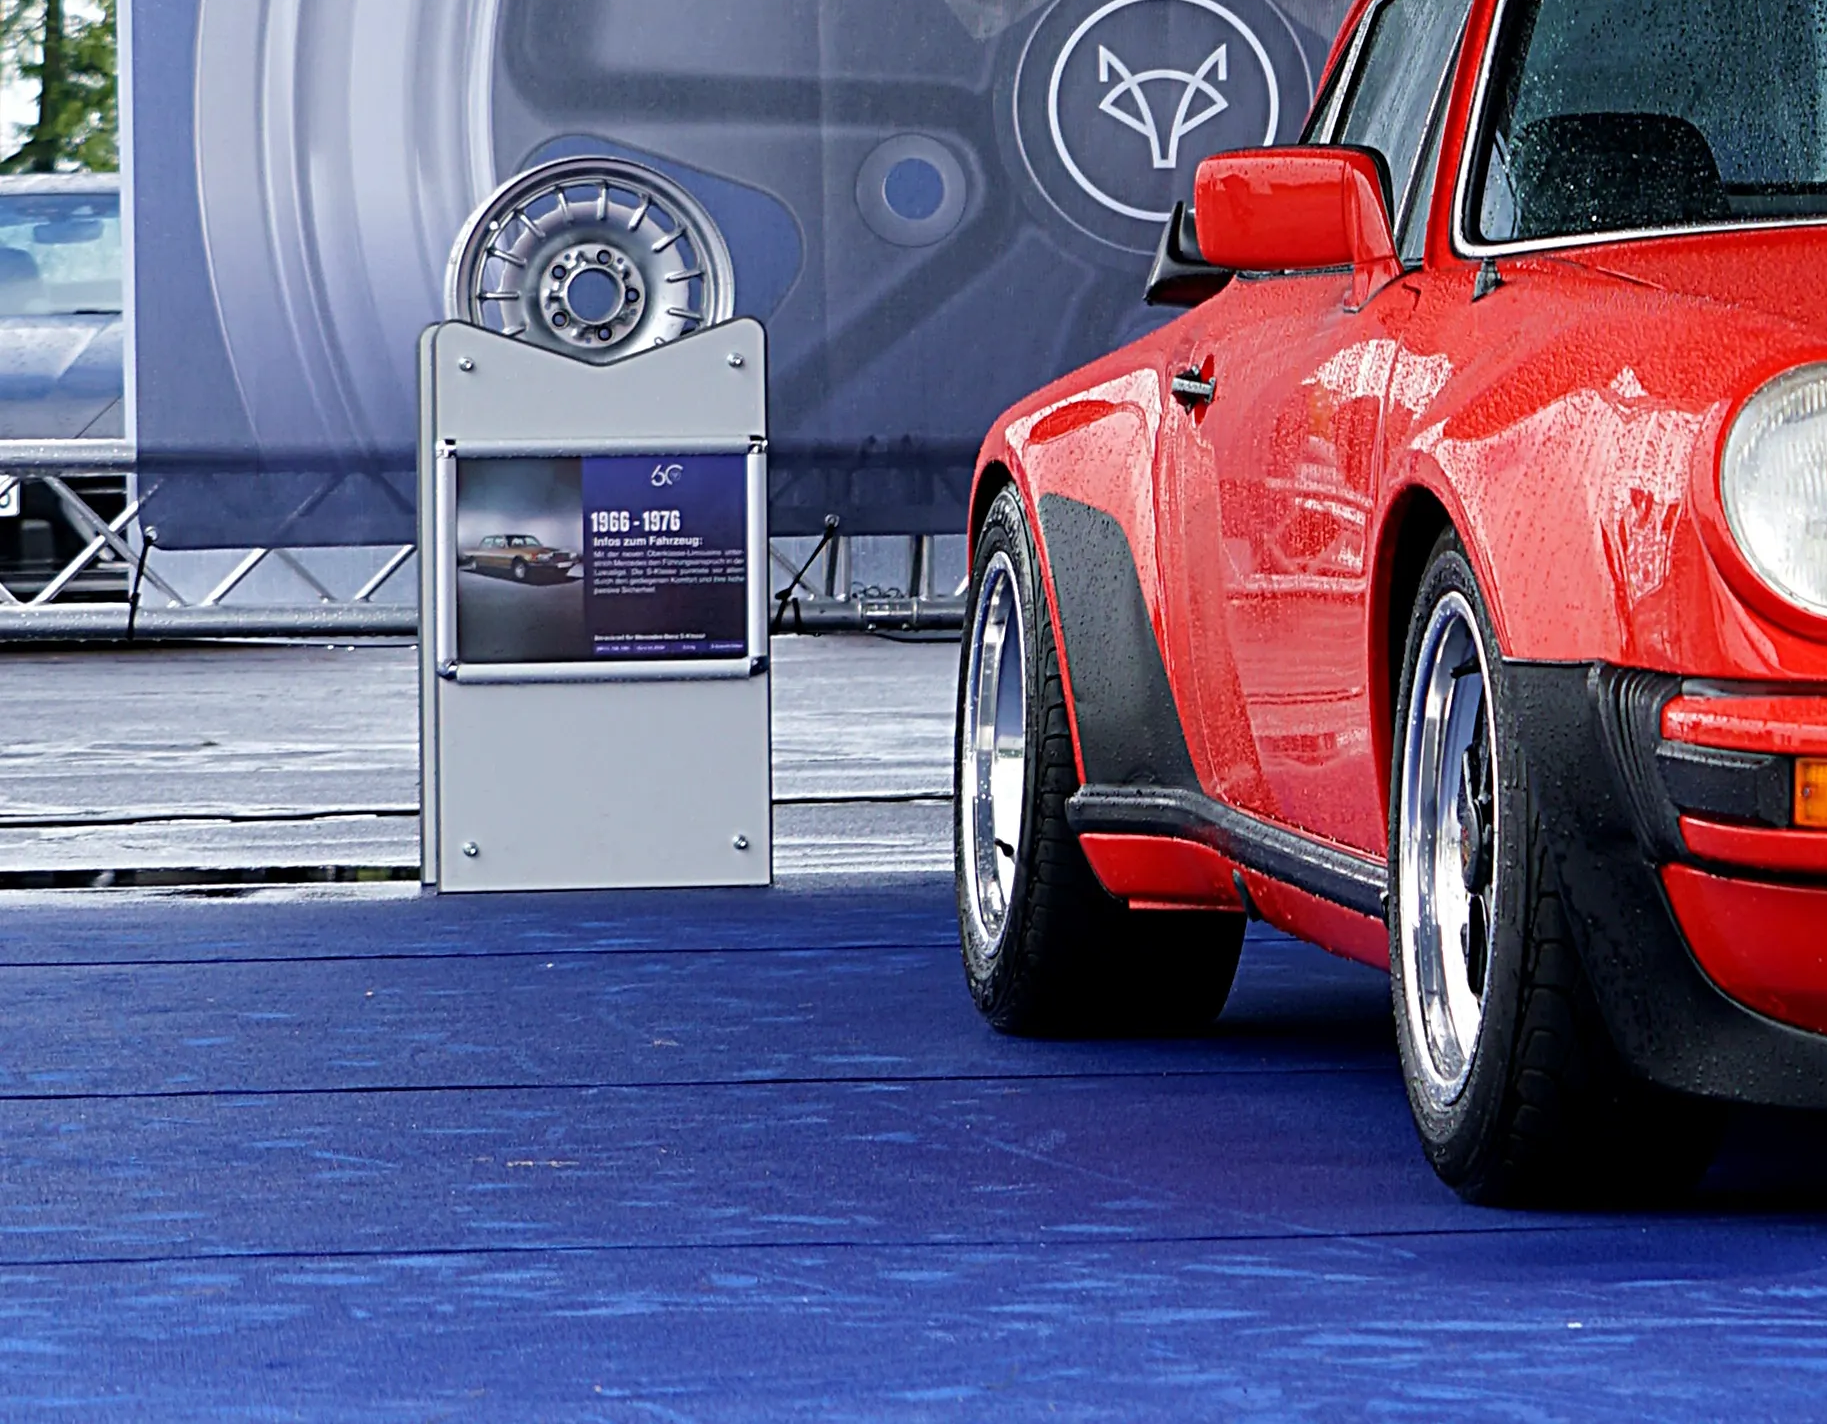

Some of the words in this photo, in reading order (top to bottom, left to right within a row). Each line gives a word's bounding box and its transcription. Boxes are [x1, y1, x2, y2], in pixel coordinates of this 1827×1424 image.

[591, 510, 630, 532] 1966
[642, 509, 680, 532] 1976
[593, 536, 621, 547] Infos
[623, 537, 646, 546] zum
[649, 535, 704, 548] Fahrzeug:
